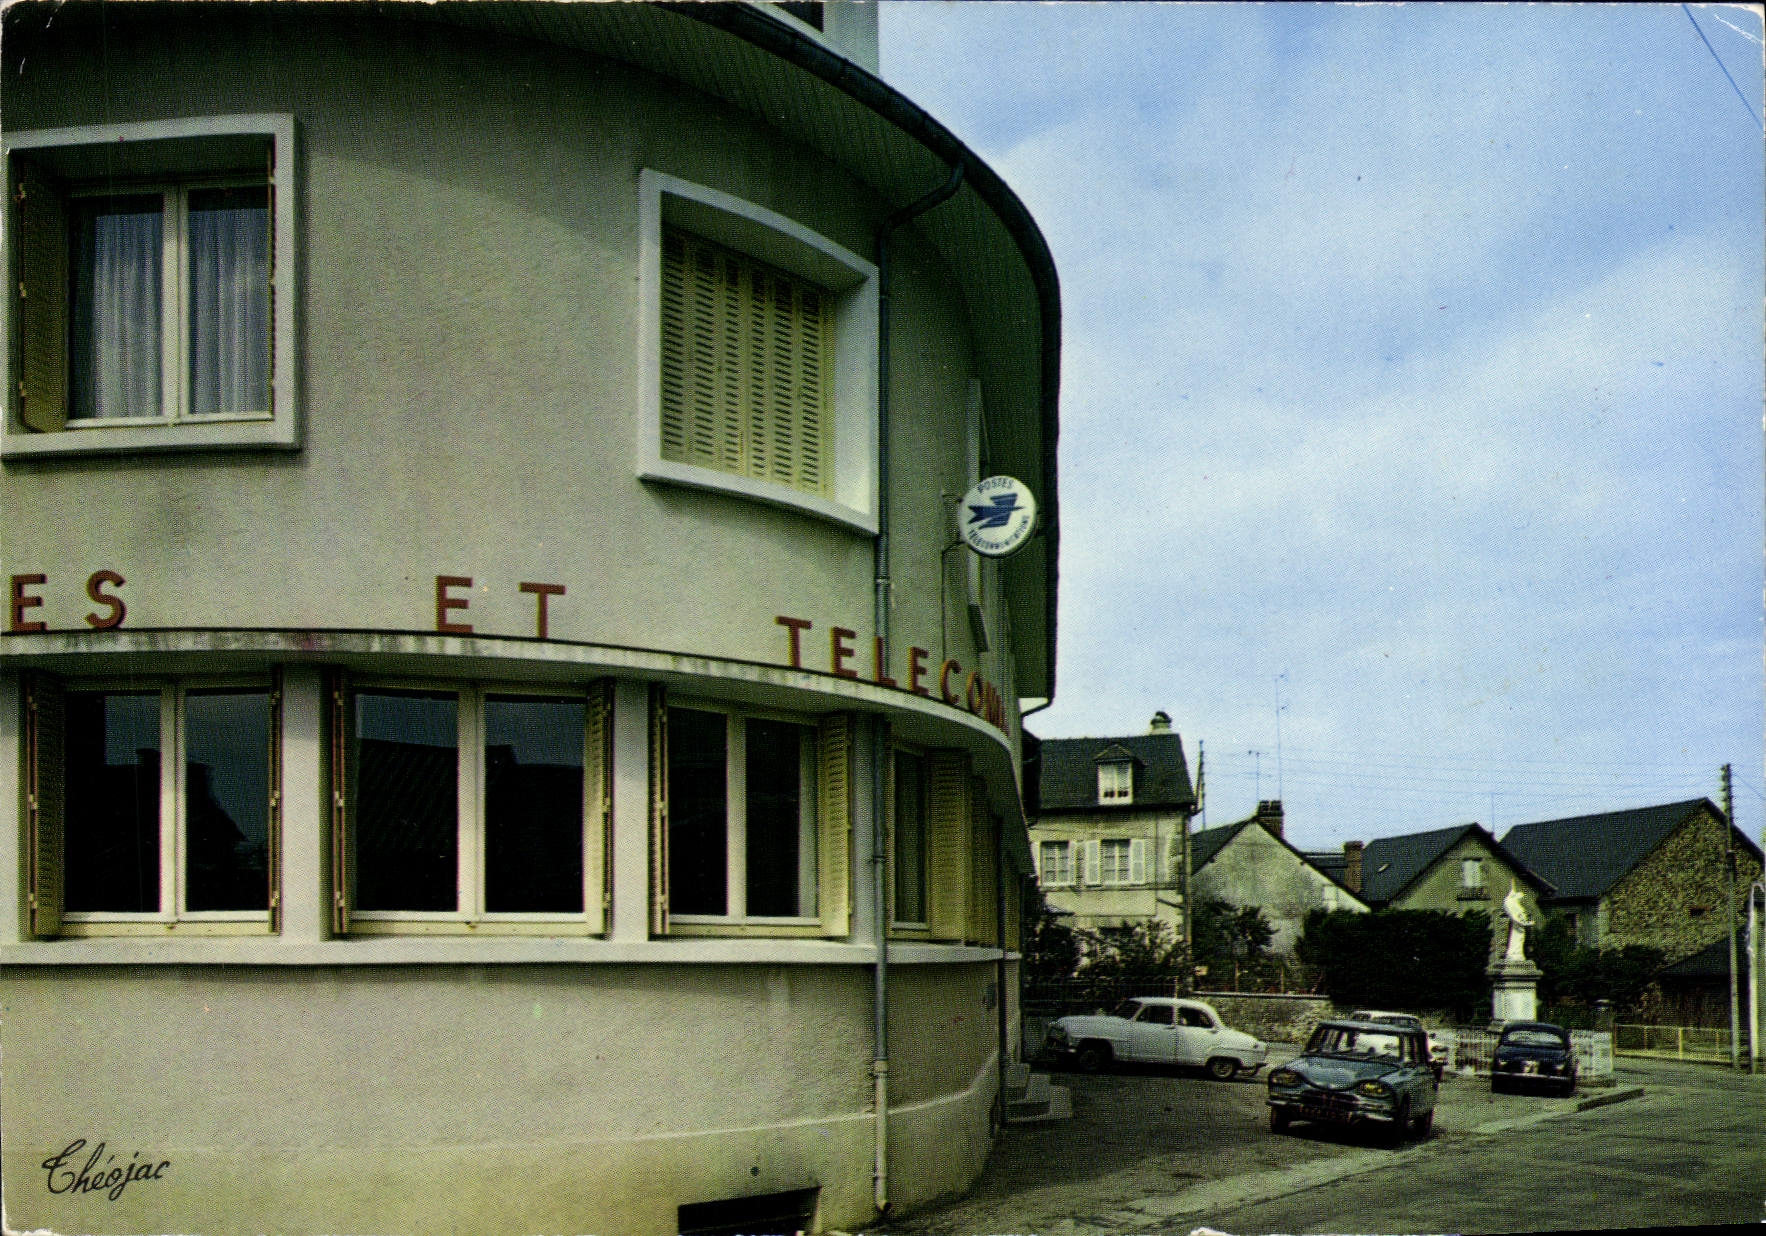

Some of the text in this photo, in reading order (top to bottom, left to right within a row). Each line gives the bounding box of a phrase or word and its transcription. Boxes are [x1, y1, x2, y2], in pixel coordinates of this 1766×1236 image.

[978, 478, 1014, 494] POSTES
[10, 570, 128, 632] ES
[436, 575, 566, 639] ET
